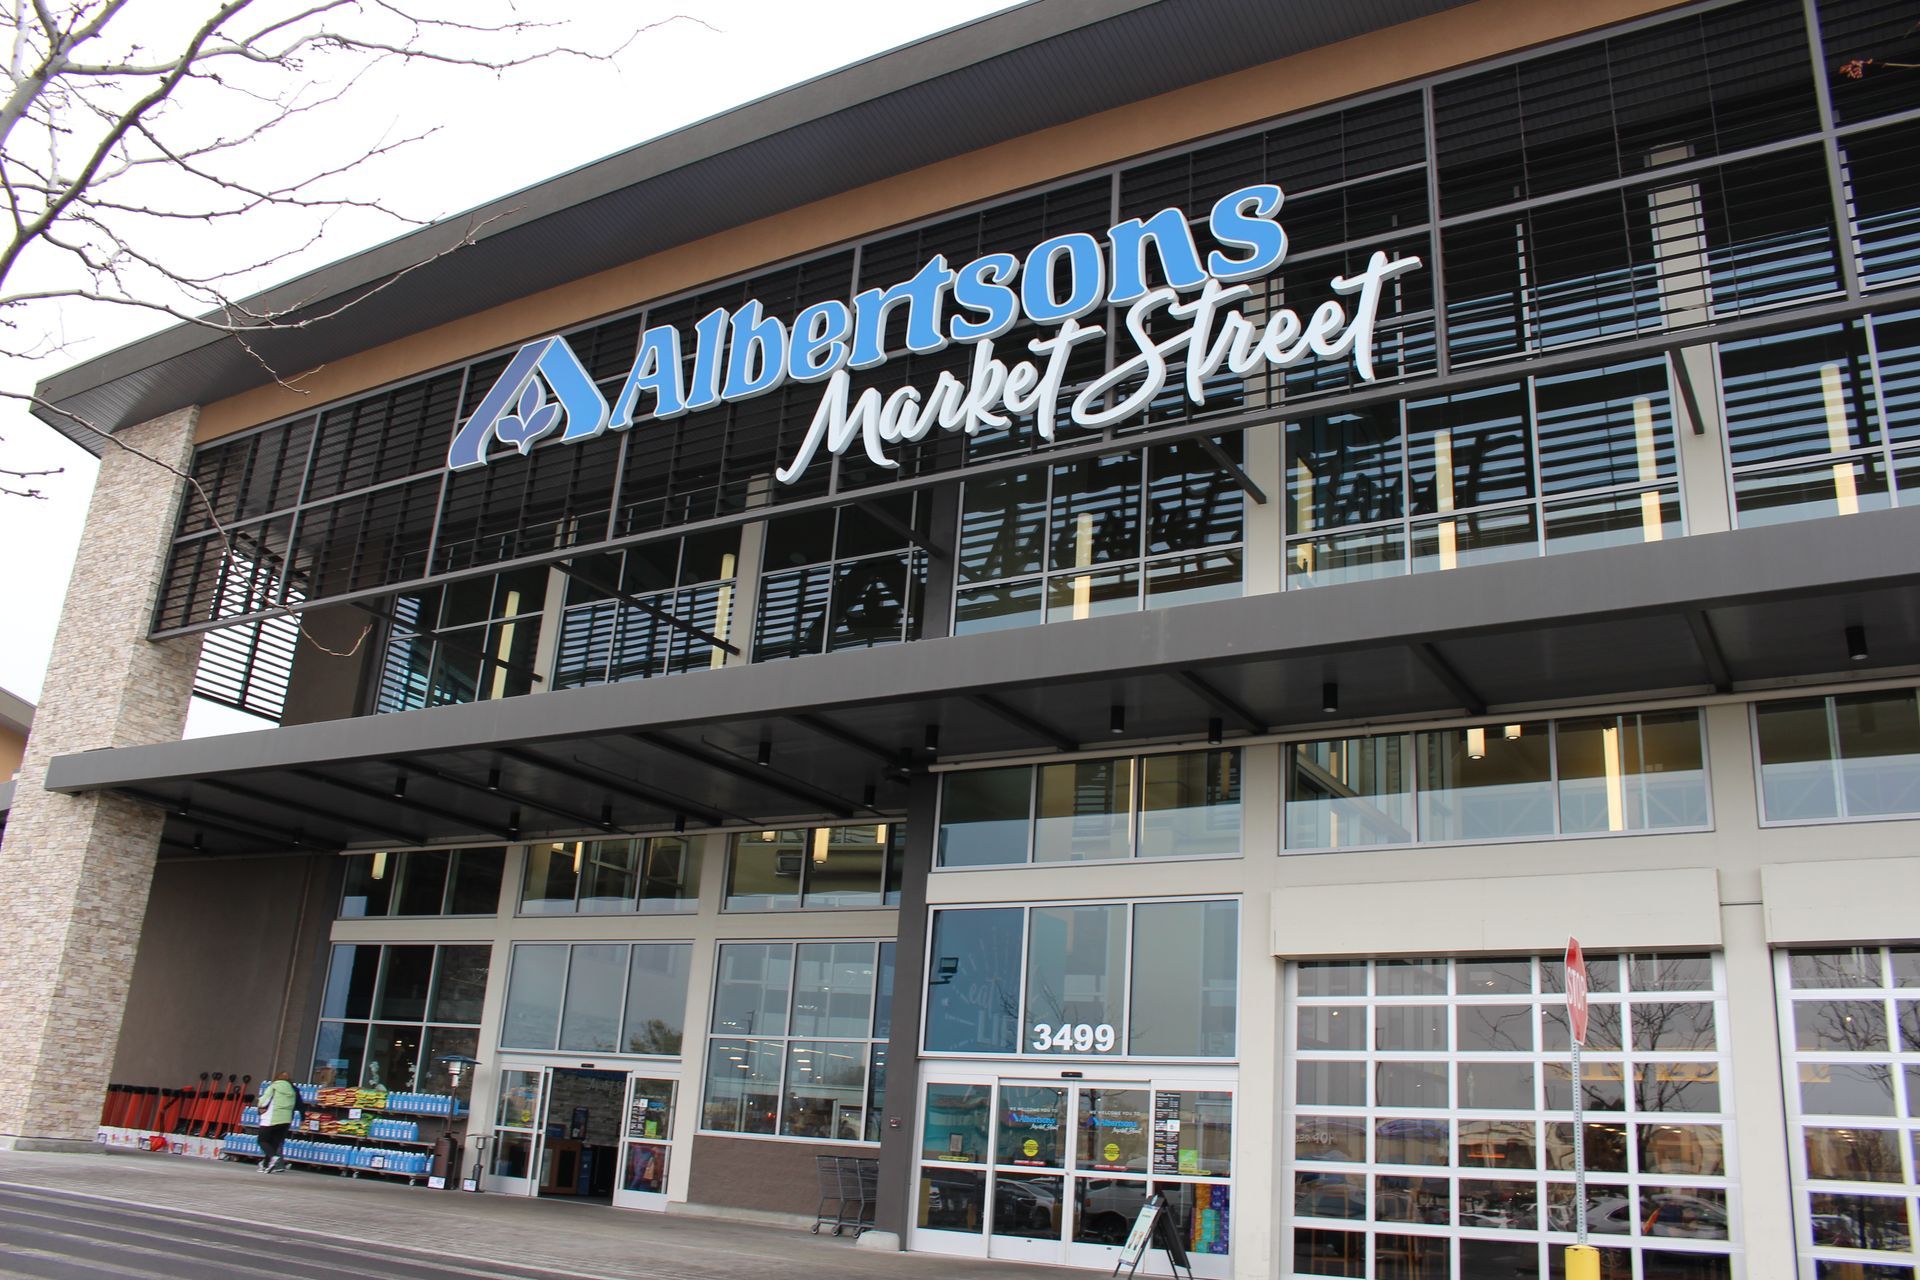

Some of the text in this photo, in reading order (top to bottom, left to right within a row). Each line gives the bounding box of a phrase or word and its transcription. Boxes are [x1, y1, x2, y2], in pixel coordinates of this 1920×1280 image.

[608, 183, 1289, 428] Albertsons
[776, 250, 1422, 485] Market Street
[1033, 1023, 1115, 1052] 3499
[1567, 965, 1585, 1011] STOP
